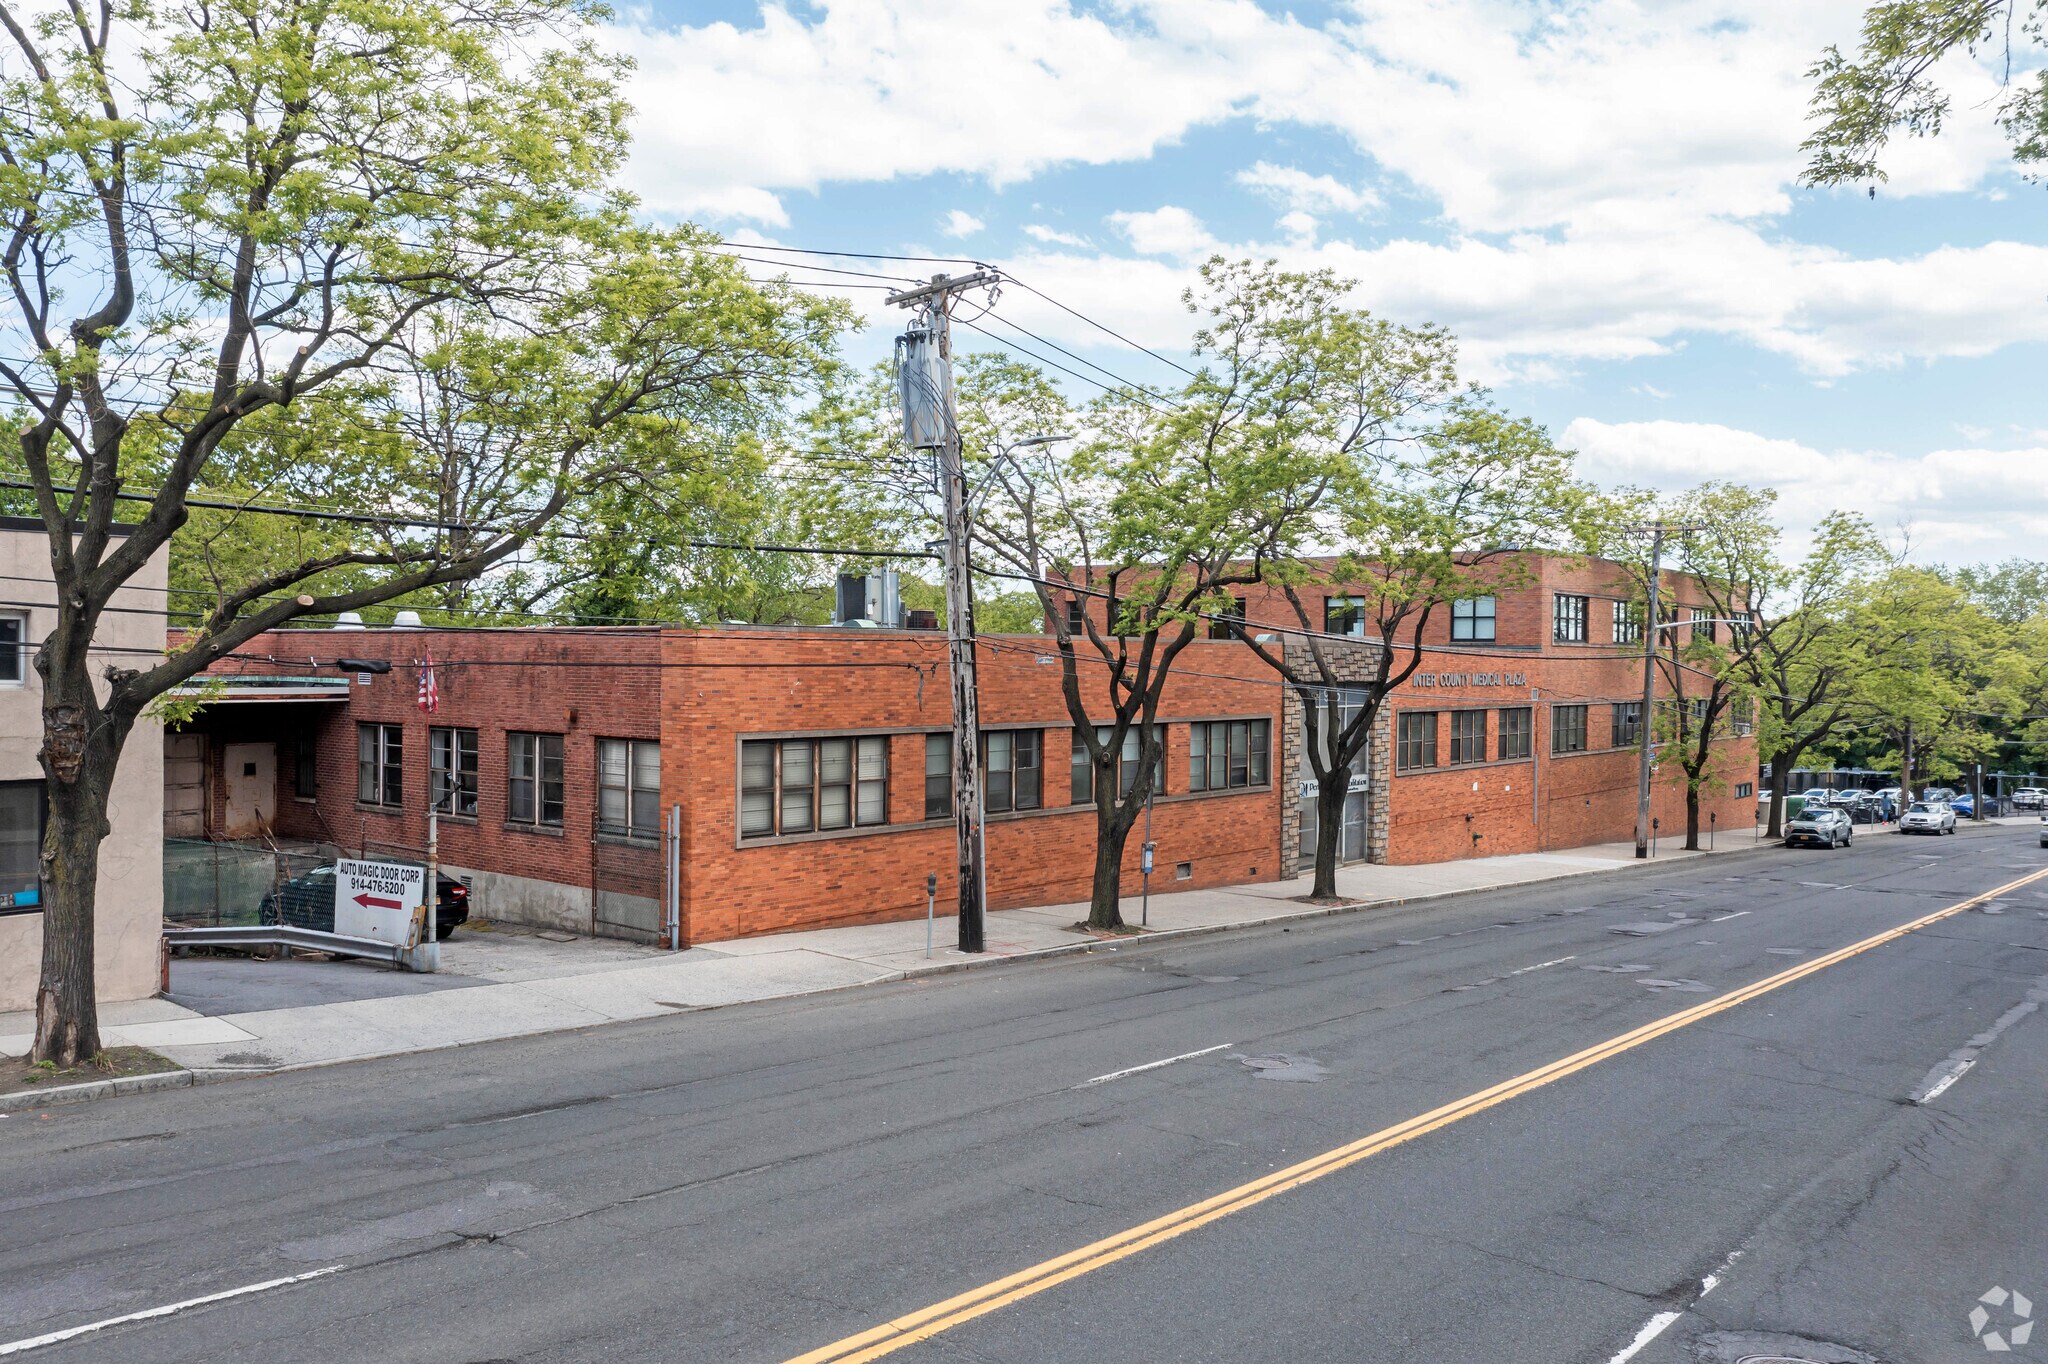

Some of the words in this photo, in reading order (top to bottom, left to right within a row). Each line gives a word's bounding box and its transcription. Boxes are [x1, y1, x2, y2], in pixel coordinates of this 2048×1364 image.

[1413, 673, 1436, 687] INTER
[1440, 673, 1470, 687] COUNTY
[1472, 673, 1501, 686] MEDICAL
[1504, 672, 1527, 686] PLAZA
[340, 862, 357, 875] AUTO
[358, 863, 379, 879] MAGIC
[381, 866, 399, 881] DOOR
[401, 869, 420, 883] CORP.
[351, 878, 405, 895] 914-476-5200
